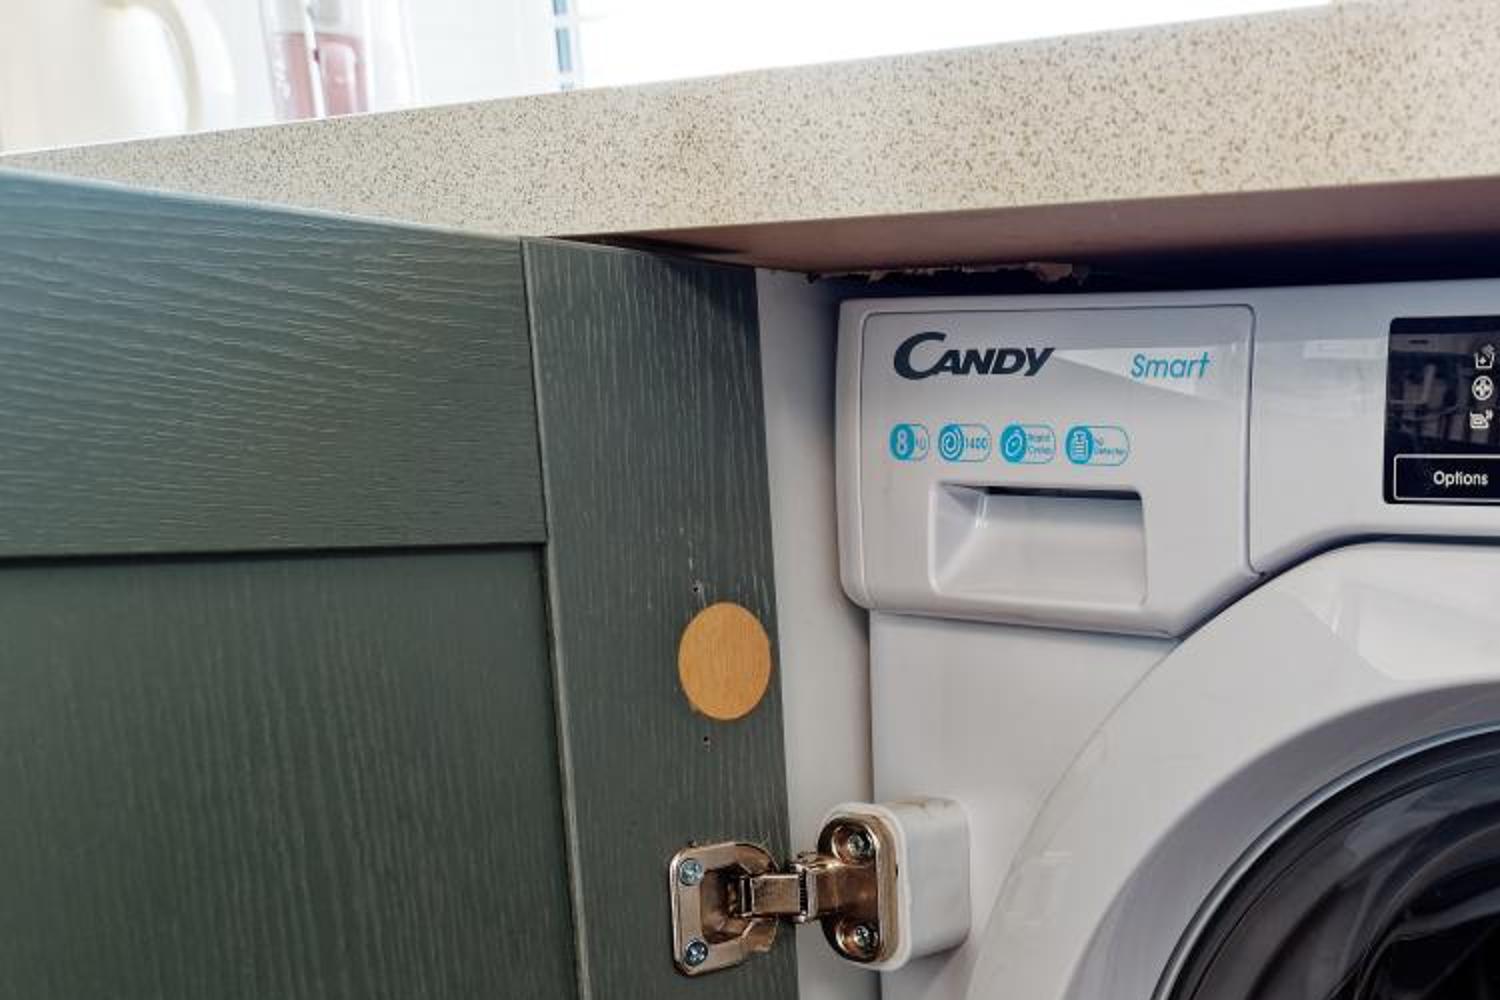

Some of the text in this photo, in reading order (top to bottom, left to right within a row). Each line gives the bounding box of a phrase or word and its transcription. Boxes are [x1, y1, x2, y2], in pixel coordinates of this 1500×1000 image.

[894, 331, 1054, 381] CANDY
[1130, 350, 1213, 381] Smart
[1433, 470, 1489, 487] Options
